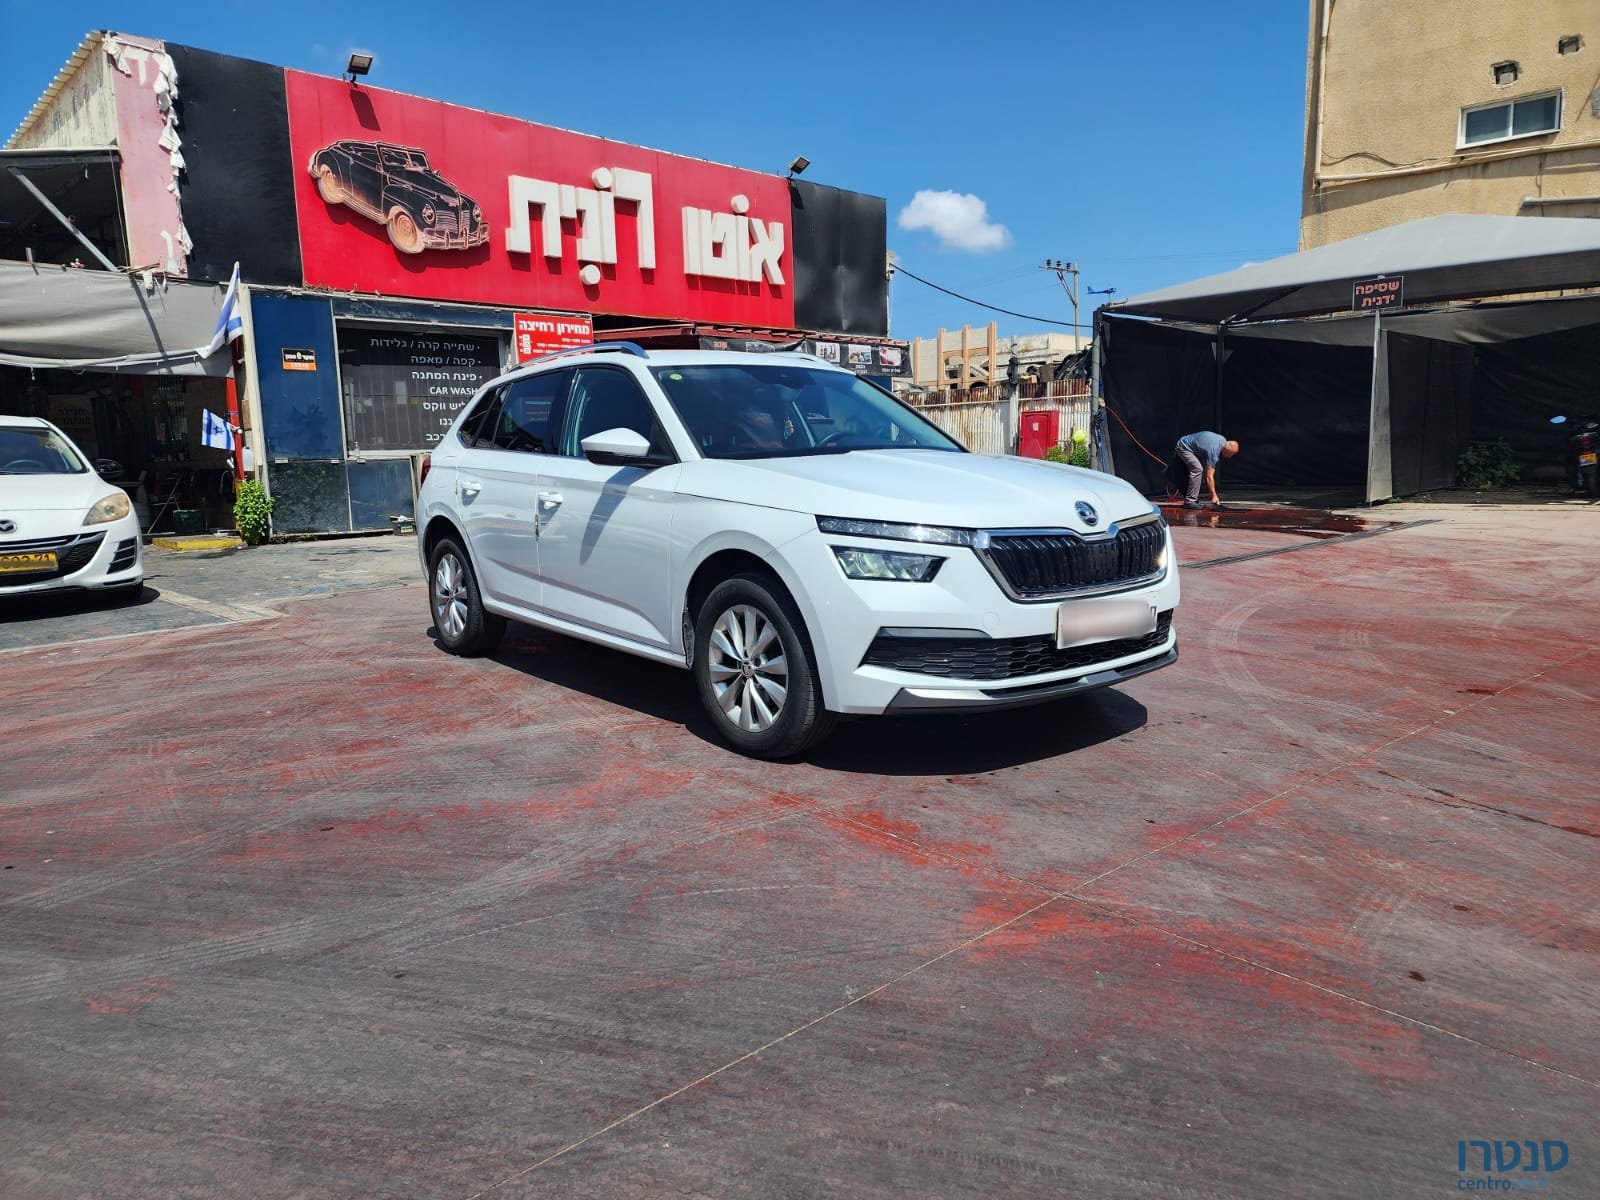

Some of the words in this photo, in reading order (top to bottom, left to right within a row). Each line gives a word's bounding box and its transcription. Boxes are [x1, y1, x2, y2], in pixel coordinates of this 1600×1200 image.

[1355, 281, 1400, 295] שטיפה
[1361, 294, 1395, 307] ידנית
[518, 320, 555, 332] רחיצה
[556, 322, 590, 336] מחירון
[370, 337, 408, 348] גלידות
[417, 340, 440, 351] קרה
[443, 341, 475, 351] שתייה
[410, 355, 442, 364] מאפה
[452, 356, 475, 367] קפה
[411, 371, 450, 380] המתנה
[452, 371, 477, 381] פינת
[429, 386, 448, 395] CAR
[450, 387, 479, 395] WASH
[423, 402, 446, 412] ווקס
